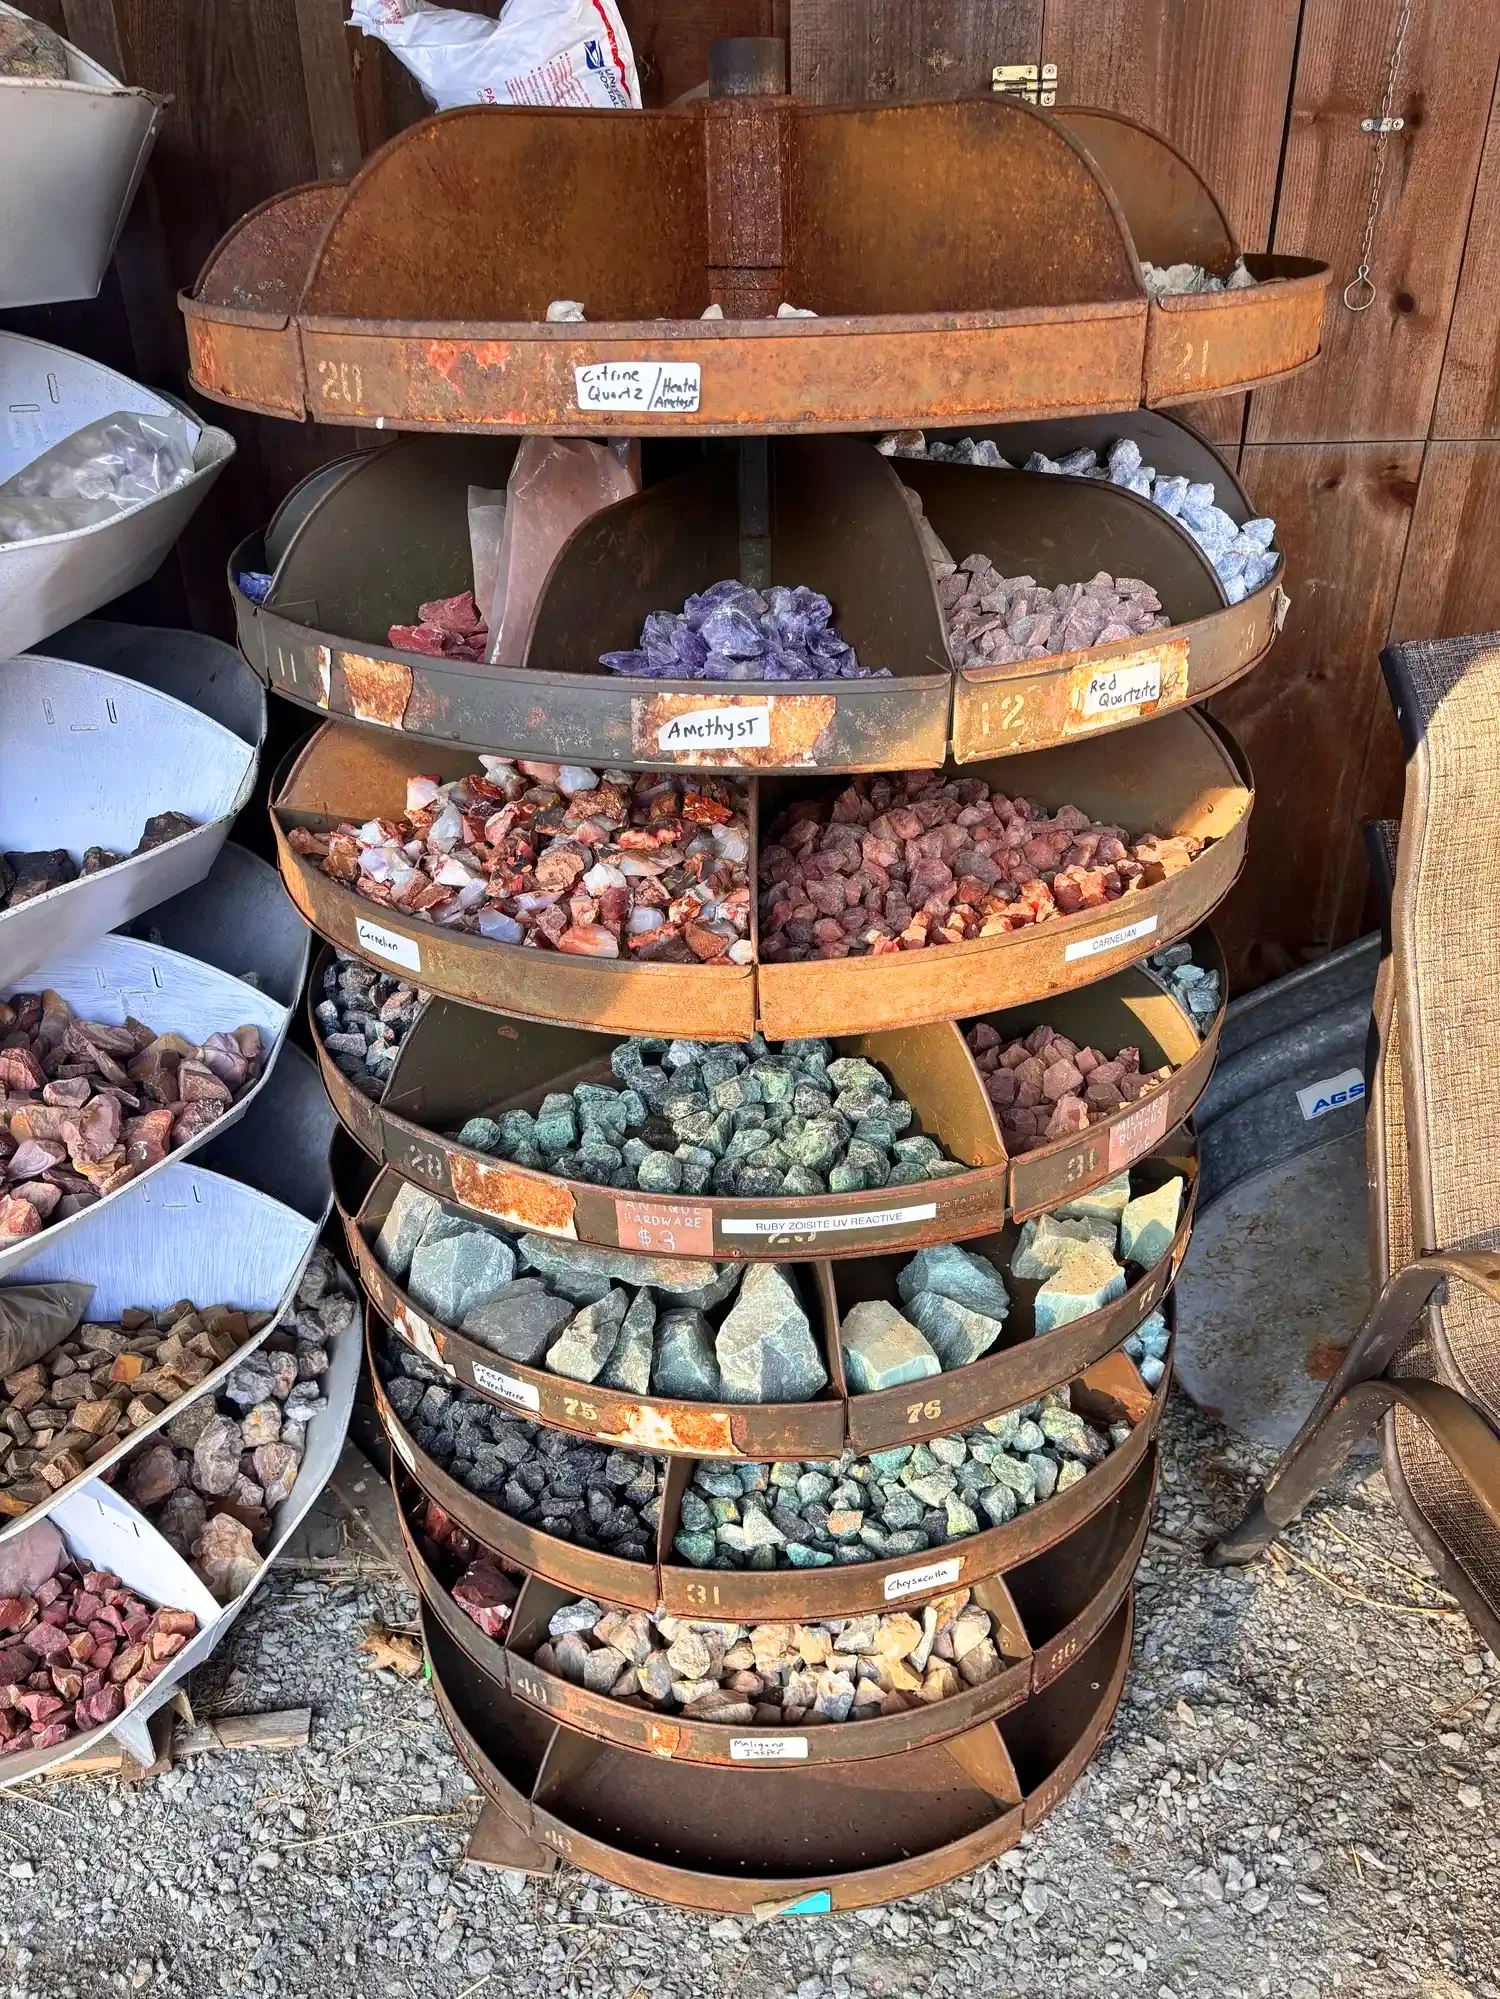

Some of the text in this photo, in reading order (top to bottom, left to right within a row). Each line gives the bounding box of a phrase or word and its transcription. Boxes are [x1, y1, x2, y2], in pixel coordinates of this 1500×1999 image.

[598, 70, 619, 108] POSTAL
[1176, 340, 1209, 380] 21
[318, 360, 363, 402] 20
[582, 366, 640, 382] Citrine
[588, 385, 643, 402] Quartz
[662, 377, 698, 397] Heated
[1090, 673, 1117, 694] Red
[1098, 680, 1157, 708] Quartzite
[982, 694, 1025, 735] 12
[359, 925, 399, 950] Carnelian
[1092, 927, 1138, 951] CARNELIAN
[1312, 1083, 1364, 1113] AGS
[624, 1213, 703, 1228] HARDWARE
[755, 1212, 903, 1231] RUBY ZOISITE UV REACTIVE
[474, 1364, 504, 1383] Green
[563, 1396, 598, 1420] 75
[906, 1400, 942, 1424] 76
[686, 1583, 720, 1605] 31
[517, 1677, 548, 1705] 40
